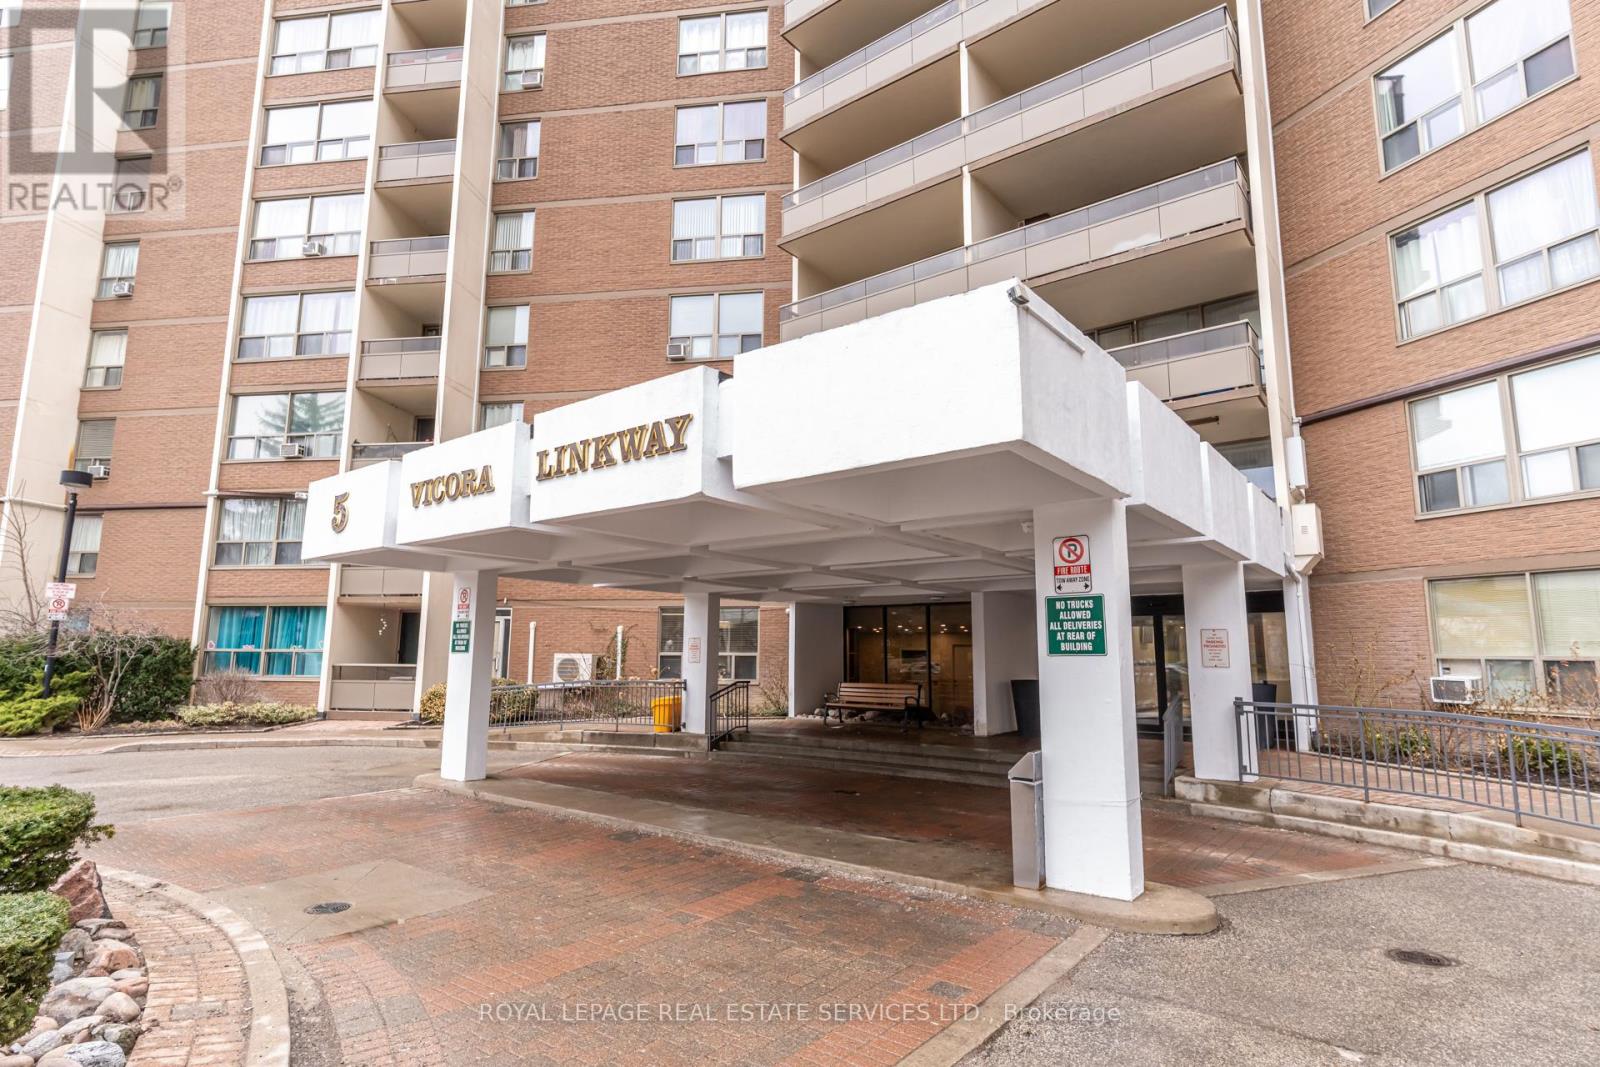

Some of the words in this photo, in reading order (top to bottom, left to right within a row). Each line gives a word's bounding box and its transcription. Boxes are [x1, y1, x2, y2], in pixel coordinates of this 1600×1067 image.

[331, 491, 350, 534] 5
[410, 464, 496, 508] VICORA
[536, 413, 694, 481] LINKWAY
[1056, 566, 1069, 575] FIRE
[1055, 600, 1066, 609] NO
[1066, 599, 1094, 609] TRUCKS
[1059, 610, 1092, 620] ALLOWED
[1049, 621, 1062, 630] ALL
[1063, 620, 1103, 630] DELIVERIES
[1056, 632, 1066, 641] AT
[1066, 631, 1085, 641] REAR
[1086, 631, 1096, 640] OF
[1060, 642, 1093, 651] BUILDING
